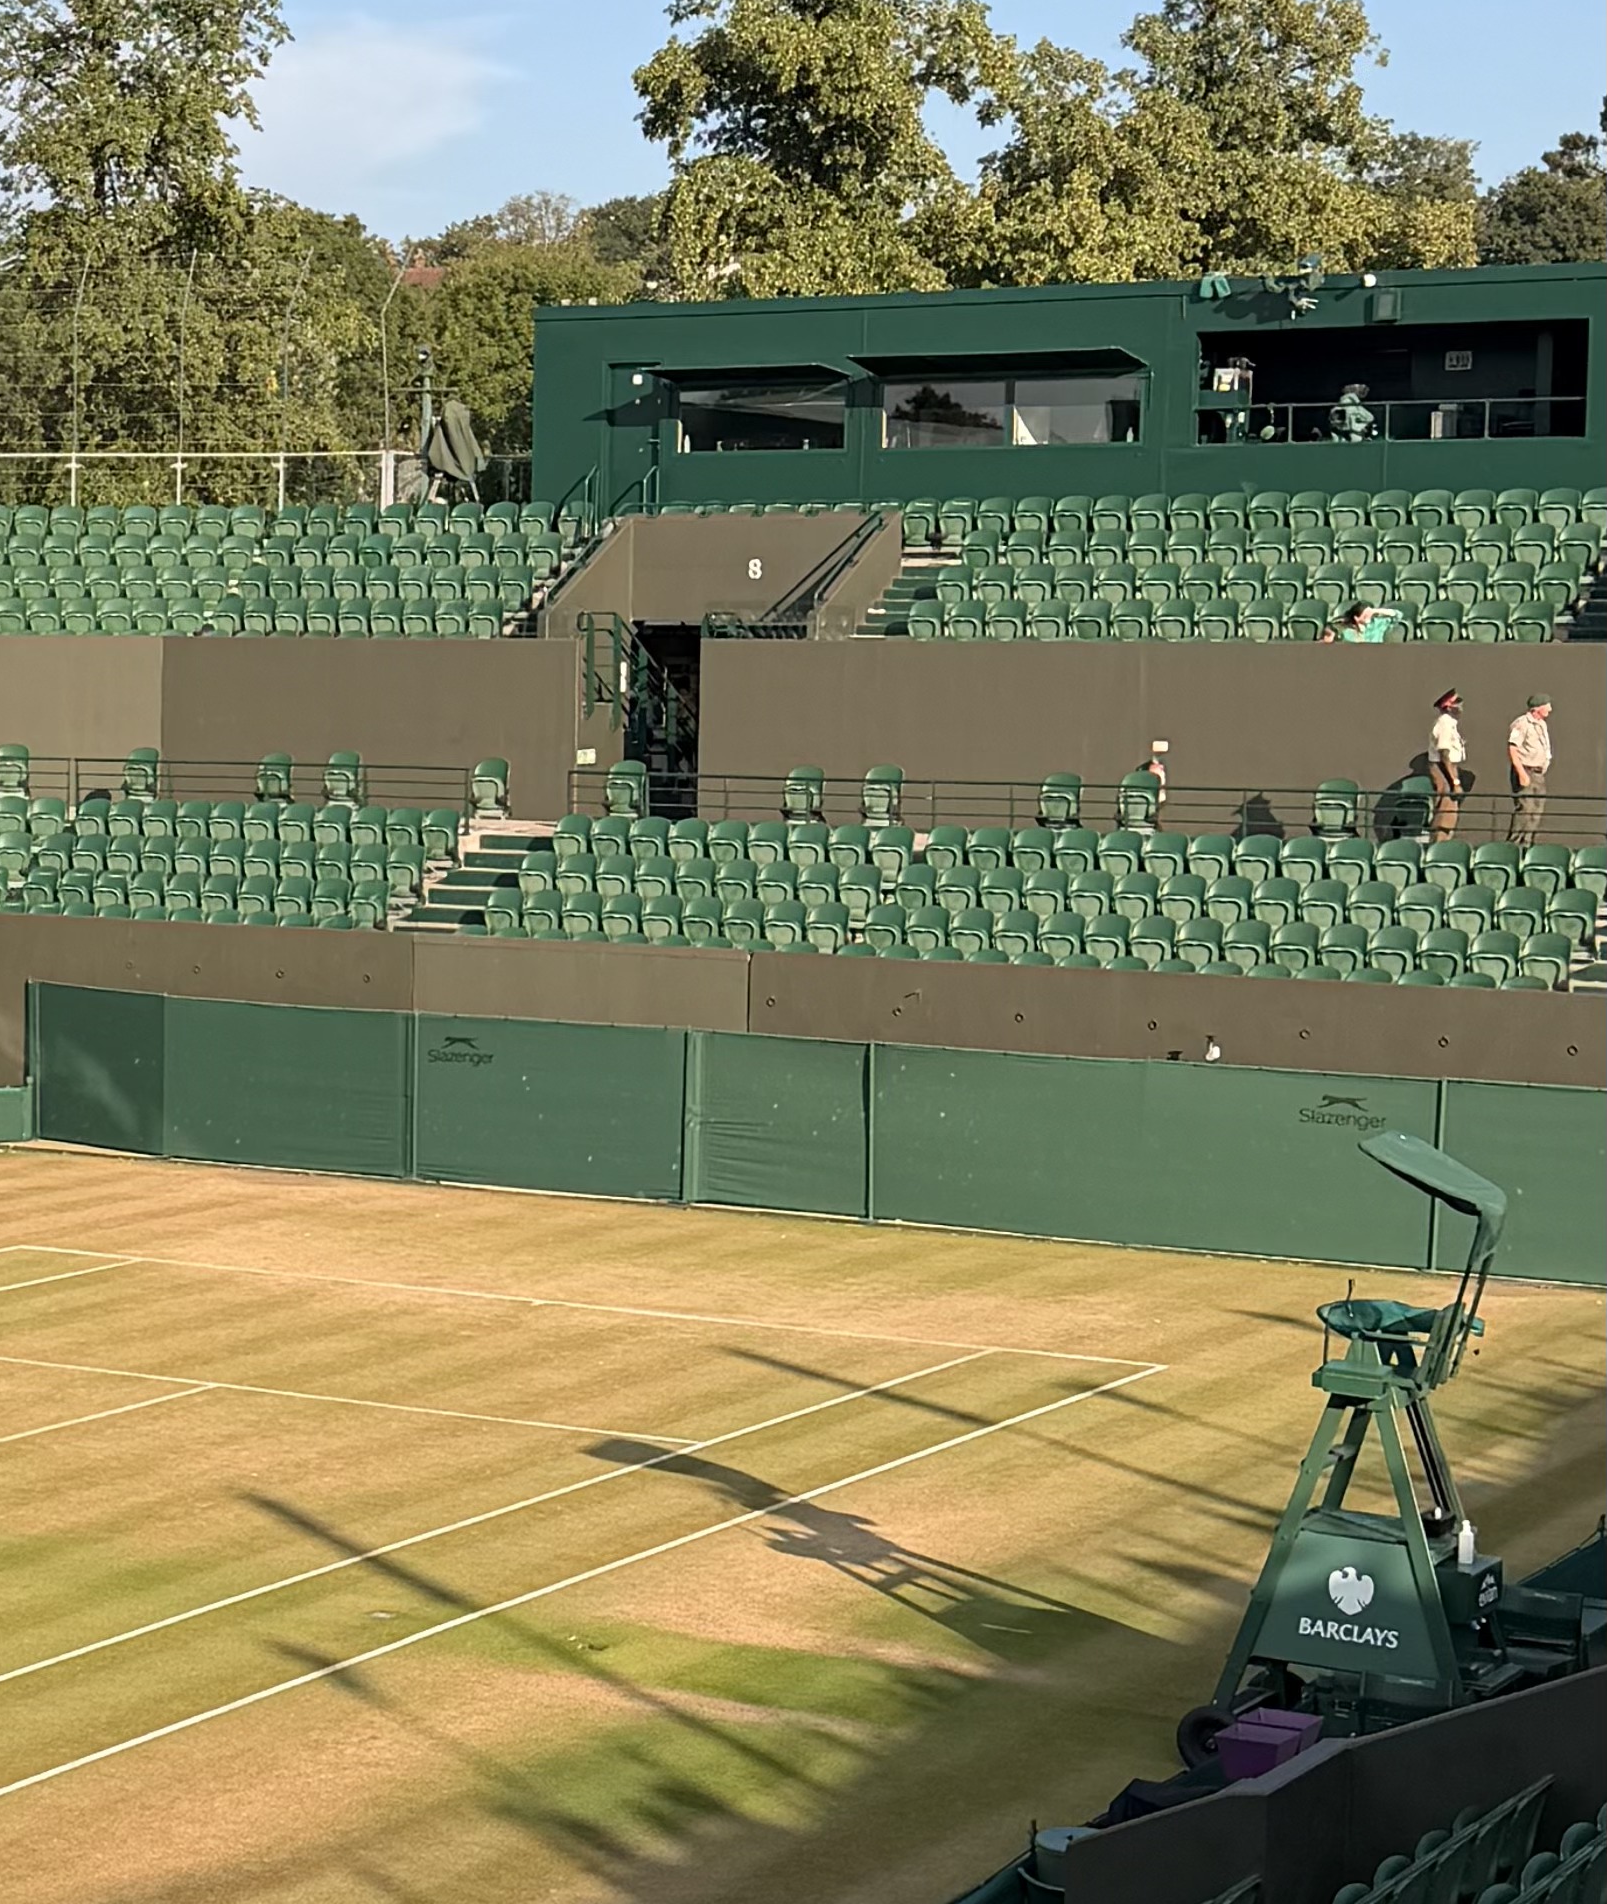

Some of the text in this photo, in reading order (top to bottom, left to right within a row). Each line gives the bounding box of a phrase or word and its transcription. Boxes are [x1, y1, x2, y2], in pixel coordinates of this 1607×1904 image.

[748, 558, 762, 580] 8
[1299, 1108, 1386, 1131] Slazenger
[1298, 1616, 1400, 1649] BARCLAYS
